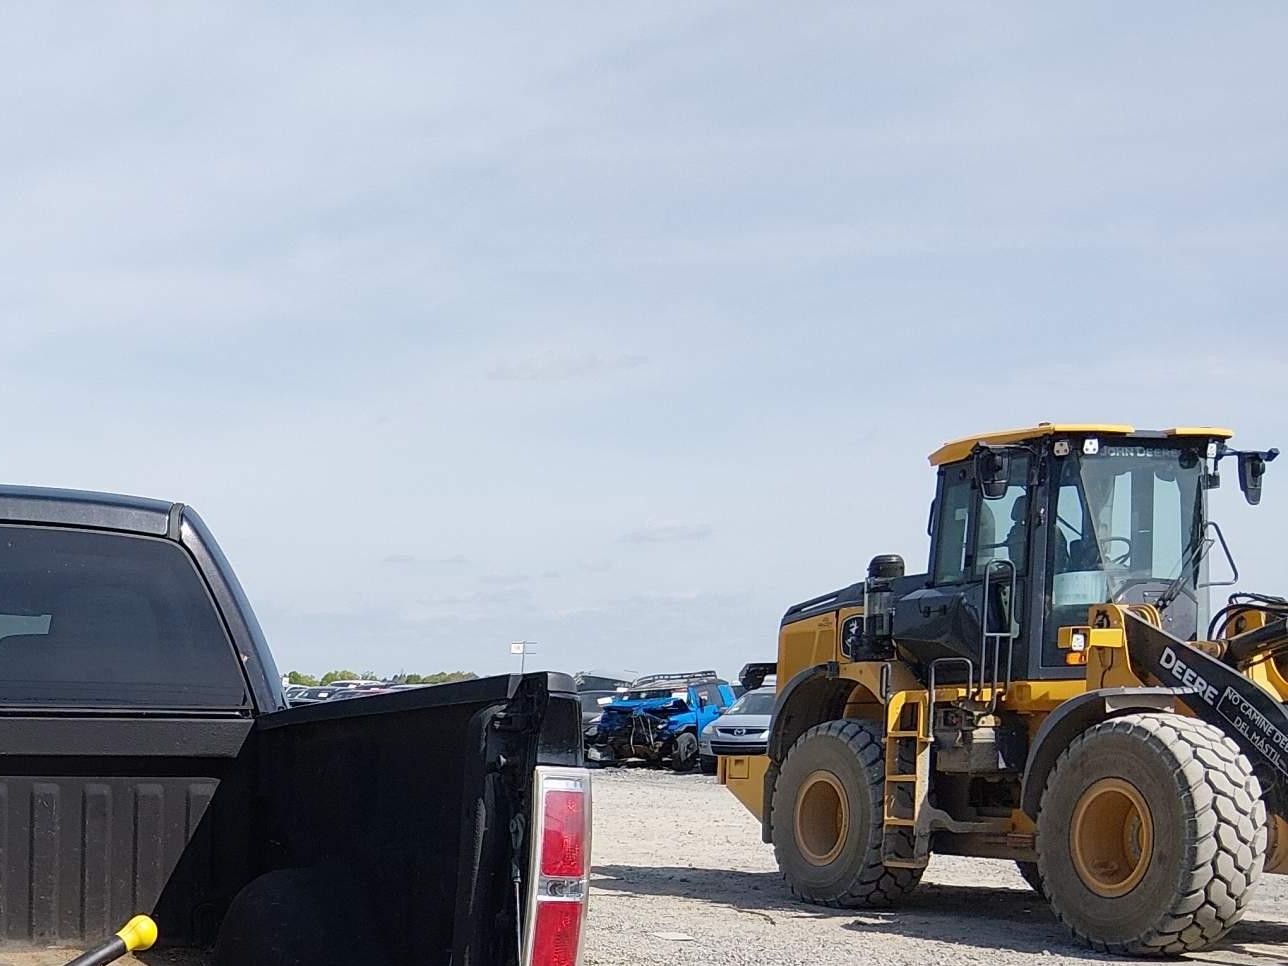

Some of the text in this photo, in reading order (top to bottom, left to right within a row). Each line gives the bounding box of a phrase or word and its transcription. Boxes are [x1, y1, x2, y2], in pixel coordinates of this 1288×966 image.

[1100, 446, 1181, 457] JOHN DEERE
[1159, 646, 1219, 706] DEERE
[1226, 688, 1240, 705] NO
[1240, 702, 1273, 737] CAMINE
[1233, 716, 1251, 739] DEL
